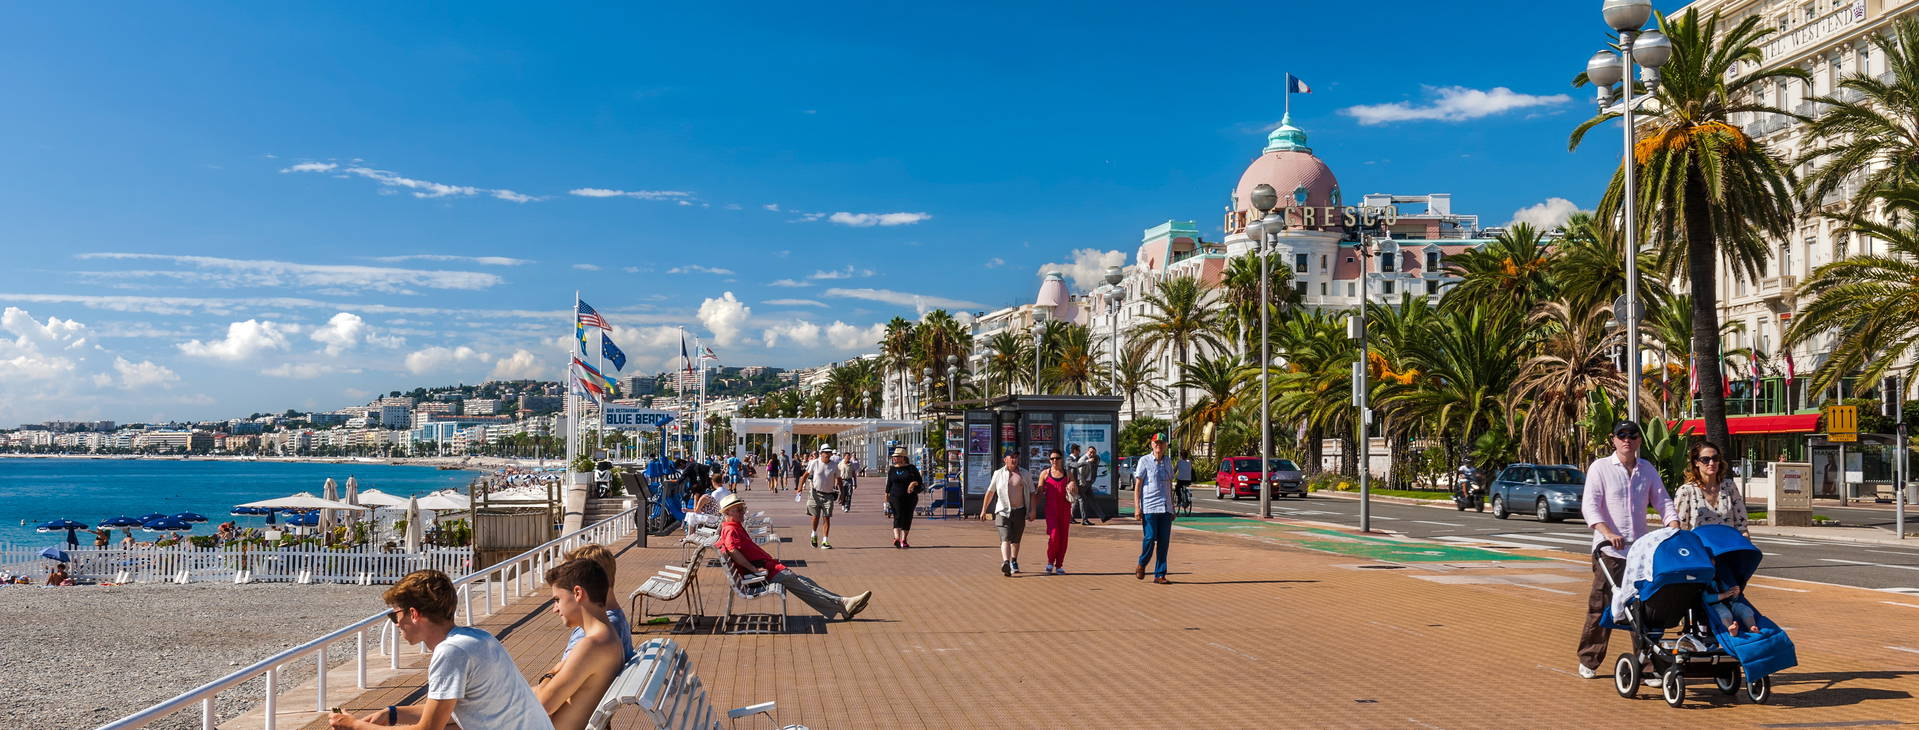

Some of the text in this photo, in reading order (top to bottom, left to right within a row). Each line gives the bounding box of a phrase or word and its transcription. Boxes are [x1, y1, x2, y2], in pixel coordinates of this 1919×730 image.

[1791, 22, 1820, 48] WEST
[1828, 8, 1853, 33] END
[1245, 205, 1398, 228] NGRESCO
[606, 413, 632, 425] BLUE
